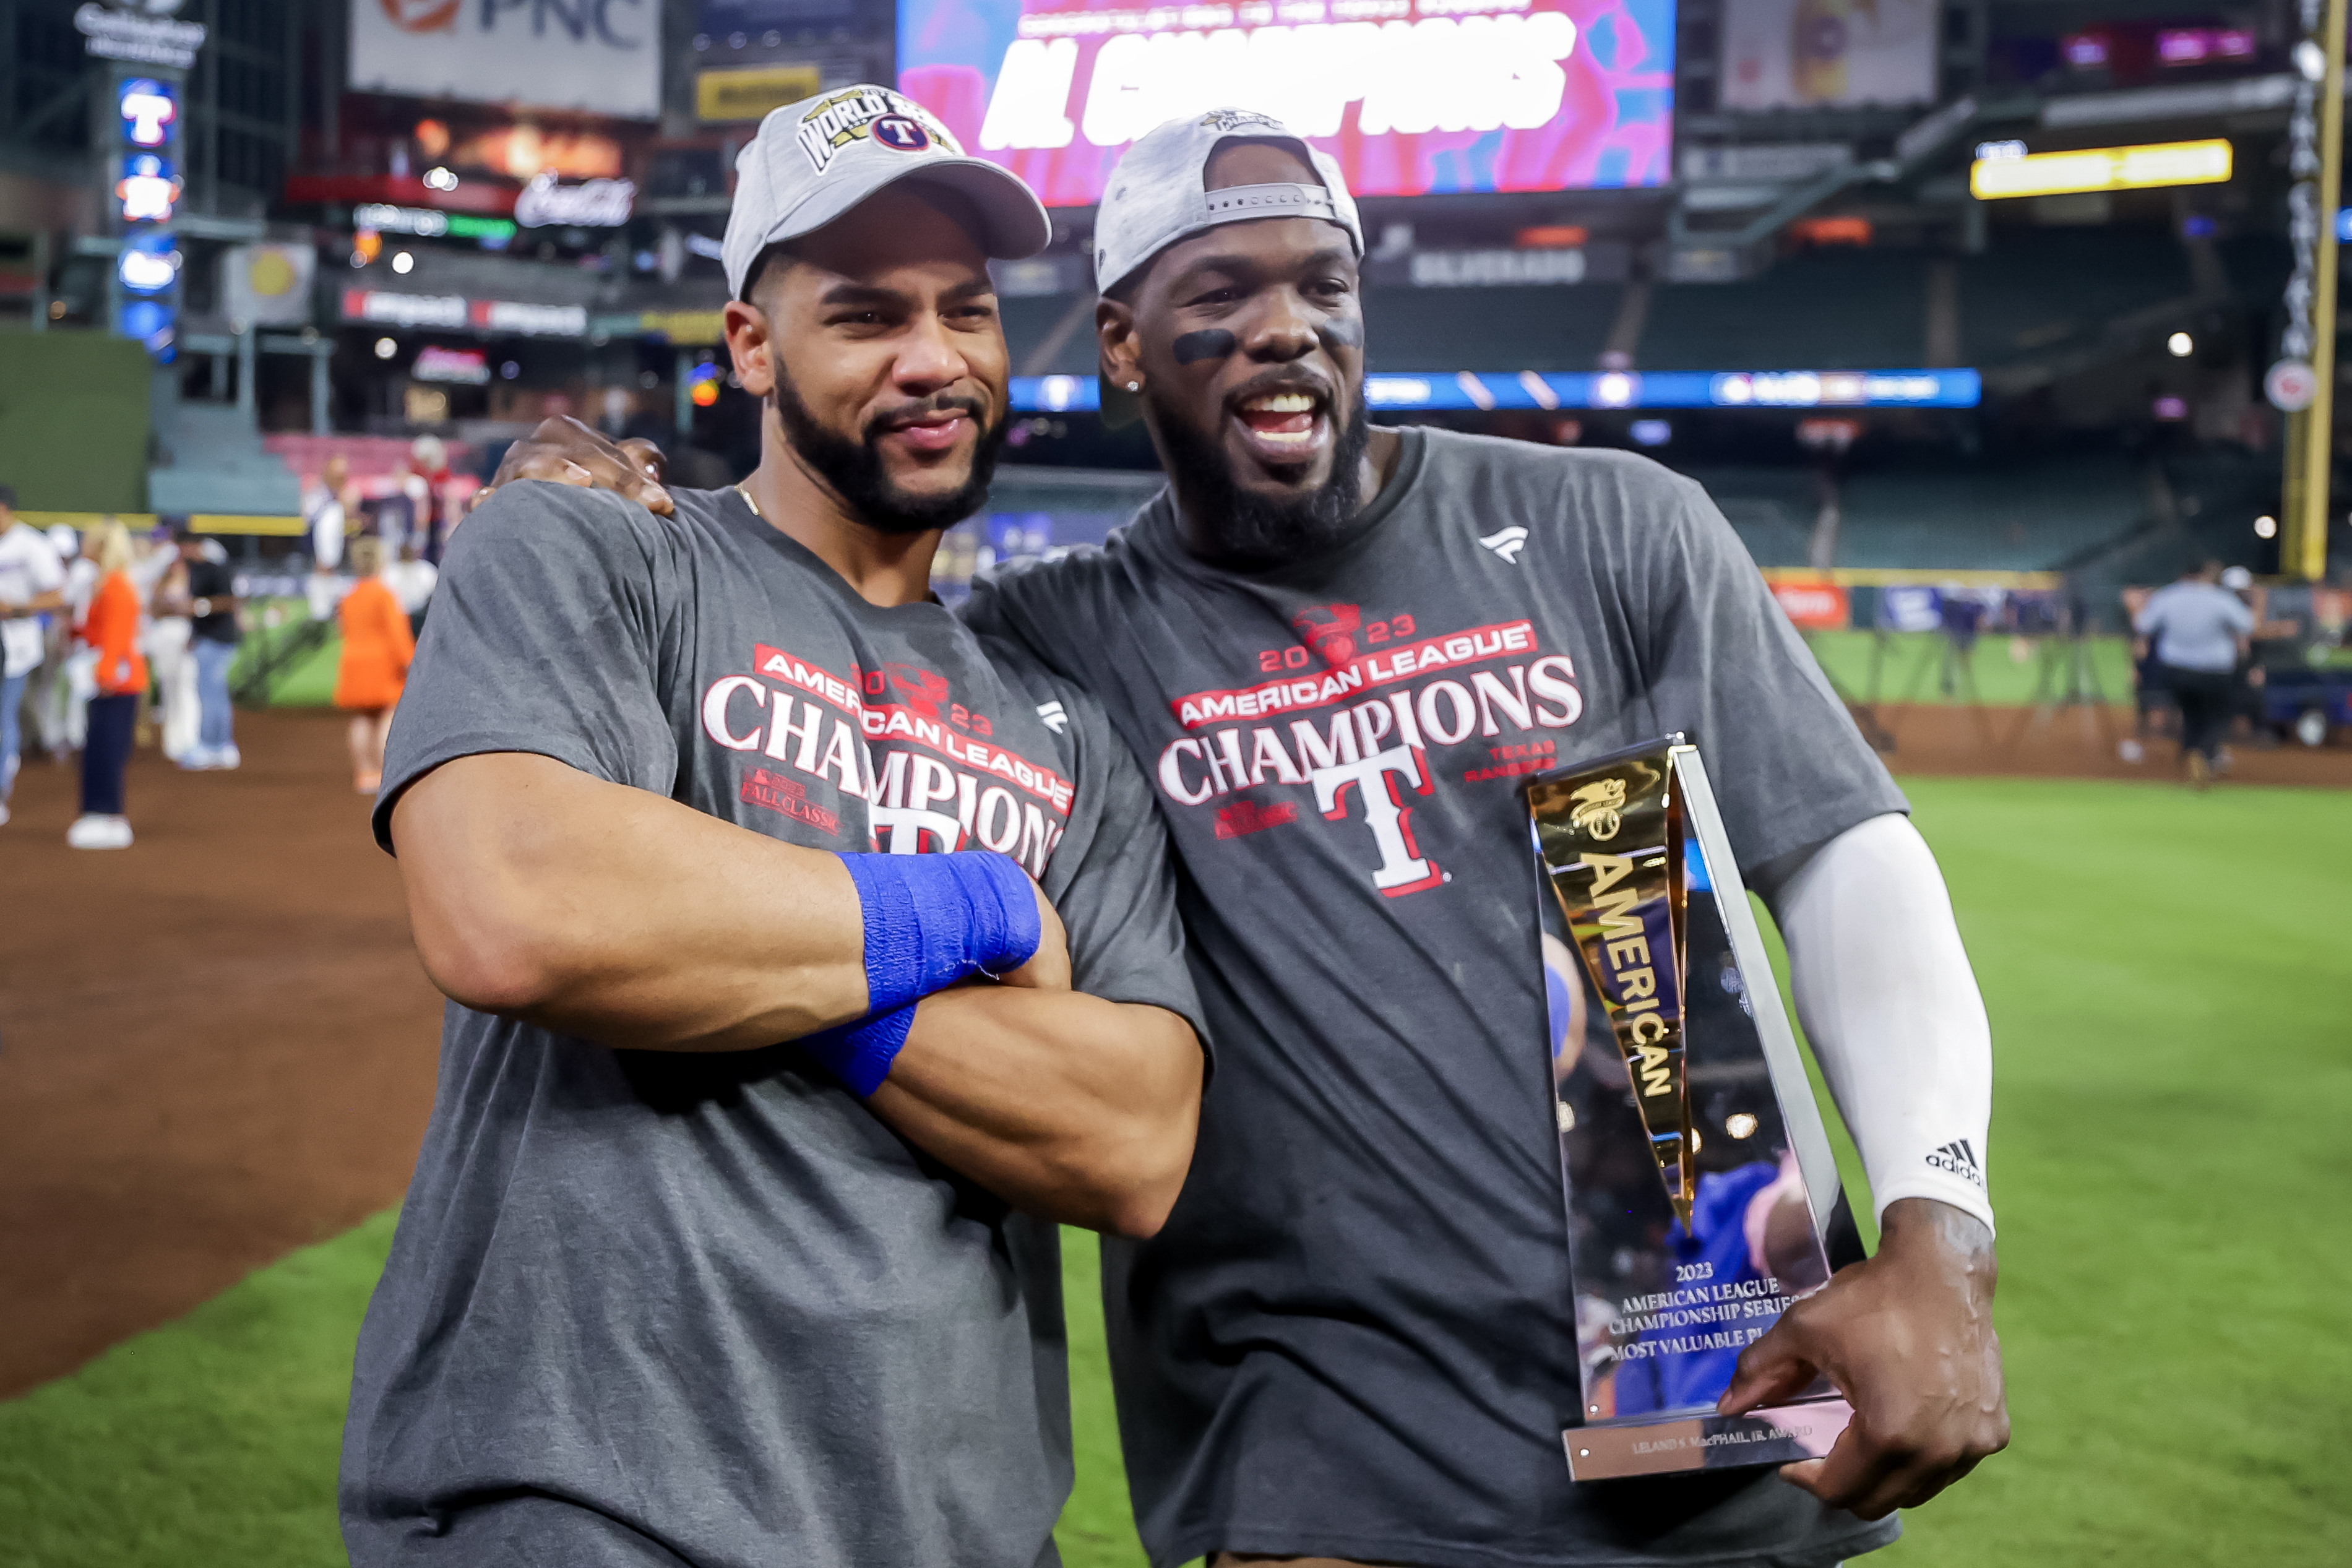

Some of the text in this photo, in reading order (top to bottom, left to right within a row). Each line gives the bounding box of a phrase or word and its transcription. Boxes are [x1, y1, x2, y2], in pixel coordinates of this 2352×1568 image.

[798, 92, 888, 171] WORLD
[881, 118, 916, 144] T
[1259, 614, 1416, 673] 20 23
[1180, 624, 1530, 726] AMERICAN LEAGUE
[950, 702, 993, 736] 23
[1158, 655, 1583, 806] CHAMPIONS
[701, 674, 1064, 879] CHAMPION
[741, 782, 780, 807] FALL
[946, 734, 1074, 811] LEAGUE
[1311, 744, 1442, 897] T
[1580, 852, 1672, 1098] AMERICAN
[1622, 1277, 1781, 1314] AMERICAN LEAGUE
[1675, 1261, 1713, 1283] 2023
[1609, 1340, 1657, 1361] MOST
[1659, 1330, 1745, 1355] VALUABLE
[1610, 1303, 1741, 1335] CHAMPIONSHIP
